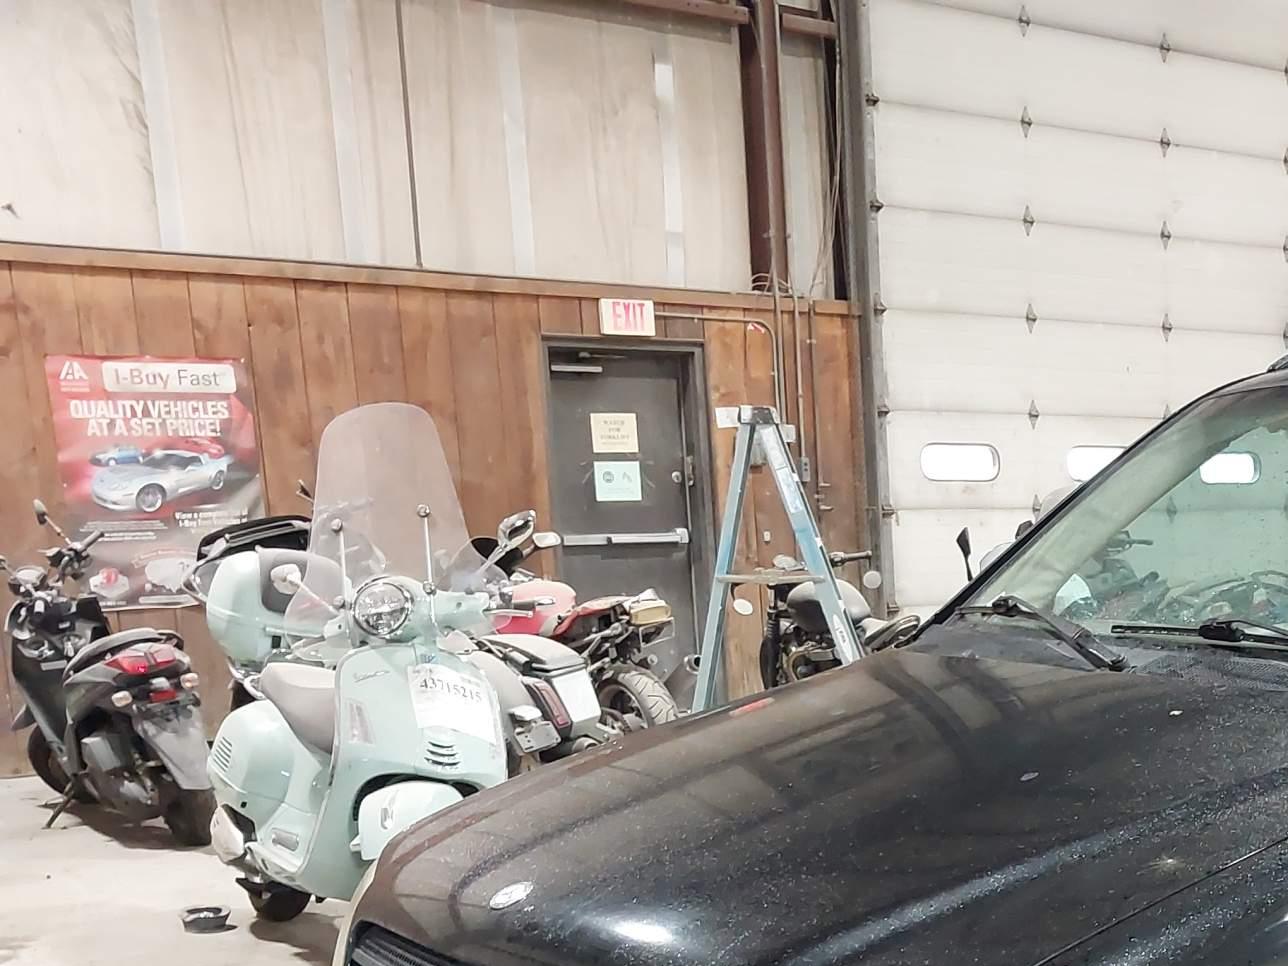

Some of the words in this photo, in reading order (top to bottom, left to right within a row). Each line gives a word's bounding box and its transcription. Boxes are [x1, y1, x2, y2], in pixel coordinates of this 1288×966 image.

[612, 301, 646, 331] EXIT
[114, 368, 170, 390] I-Buy
[177, 369, 220, 386] Fast
[69, 400, 144, 419] QUALITY
[146, 400, 229, 419] VEHICLES
[87, 419, 111, 437] AT
[113, 419, 128, 437] A
[131, 419, 162, 437] SET
[166, 419, 222, 437] PRICE!
[419, 677, 482, 703] 43715215
